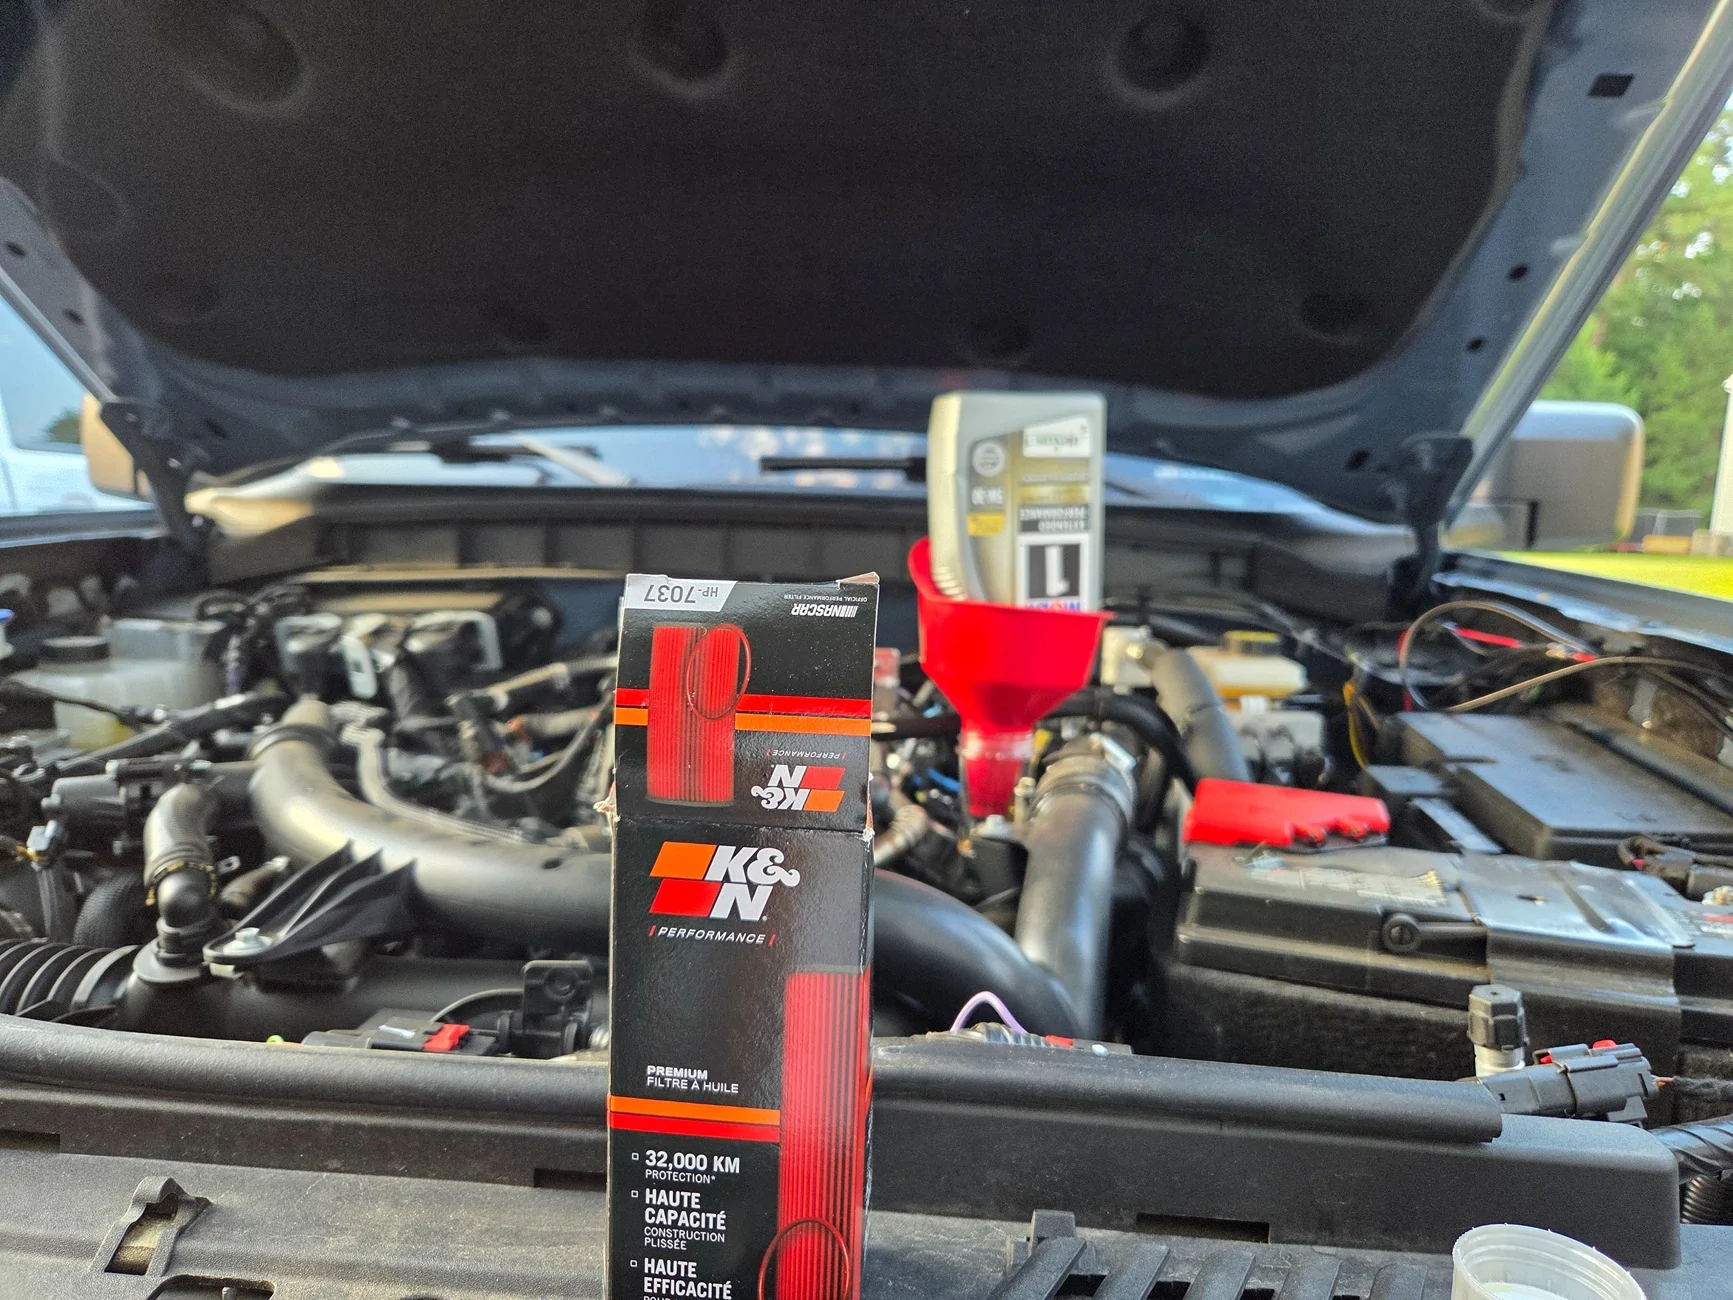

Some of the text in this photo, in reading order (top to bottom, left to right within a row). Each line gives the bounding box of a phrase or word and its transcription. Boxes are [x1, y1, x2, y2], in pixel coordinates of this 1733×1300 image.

[1020, 506, 1085, 520] PERFORMANCE
[1045, 546, 1070, 597] 1
[792, 603, 858, 618] NASCAR
[772, 749, 841, 759] PERFORMANCE
[657, 926, 766, 945] PERFORMANCE
[647, 1065, 708, 1080] PREMIUM
[647, 1076, 739, 1093] FILTRE À HUILE
[645, 1150, 740, 1174] 32,000 KM
[645, 1188, 701, 1208] HAUTE
[644, 1207, 726, 1230] CAPACITÉ
[644, 1226, 725, 1243] CONSTRUCTION
[644, 1237, 687, 1250] PLISSÉE
[644, 1257, 697, 1278] HAUTE
[644, 1277, 732, 1300] EFFICACITÉ
